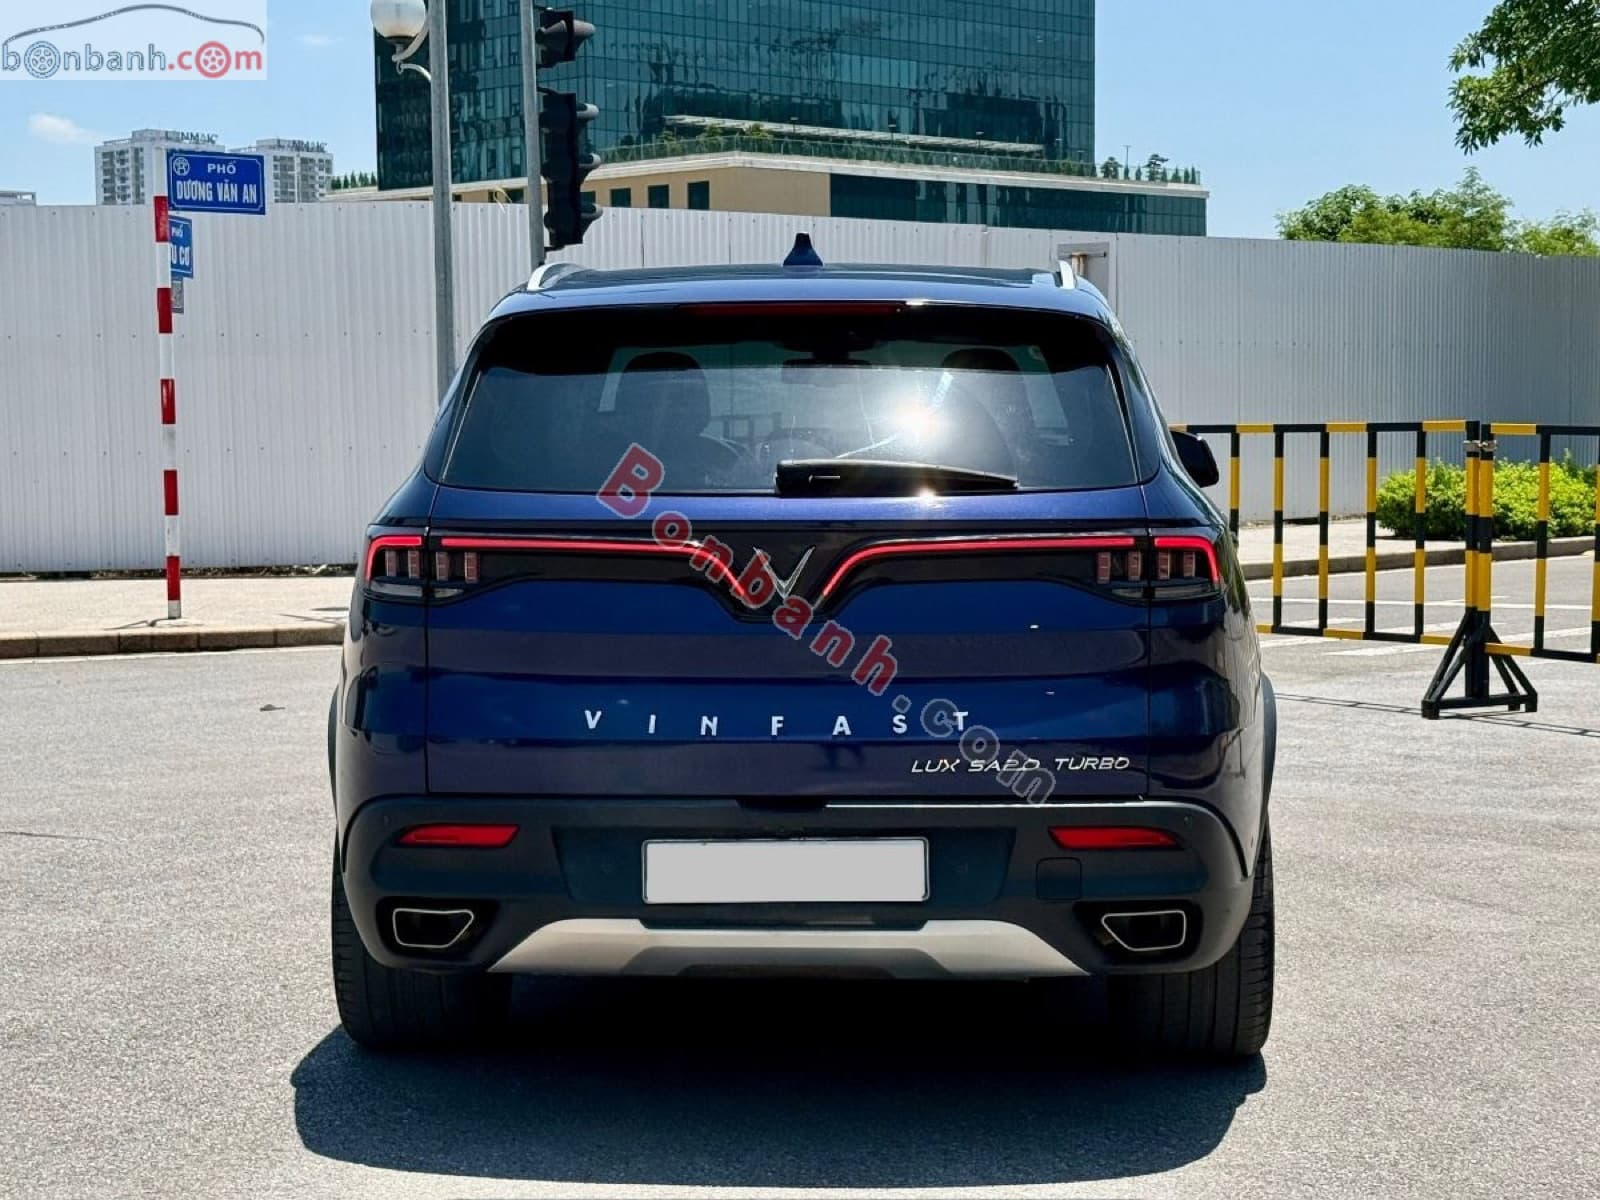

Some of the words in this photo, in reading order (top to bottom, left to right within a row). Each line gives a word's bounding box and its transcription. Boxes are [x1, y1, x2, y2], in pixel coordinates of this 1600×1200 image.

[207, 160, 237, 175] PHỐ
[176, 179, 213, 202] DƯƠNG
[216, 179, 238, 203] VĂN
[242, 183, 257, 204] AN
[584, 708, 969, 737] VINFAST
[911, 758, 961, 773] LUX
[1054, 757, 1131, 771] TURBO
